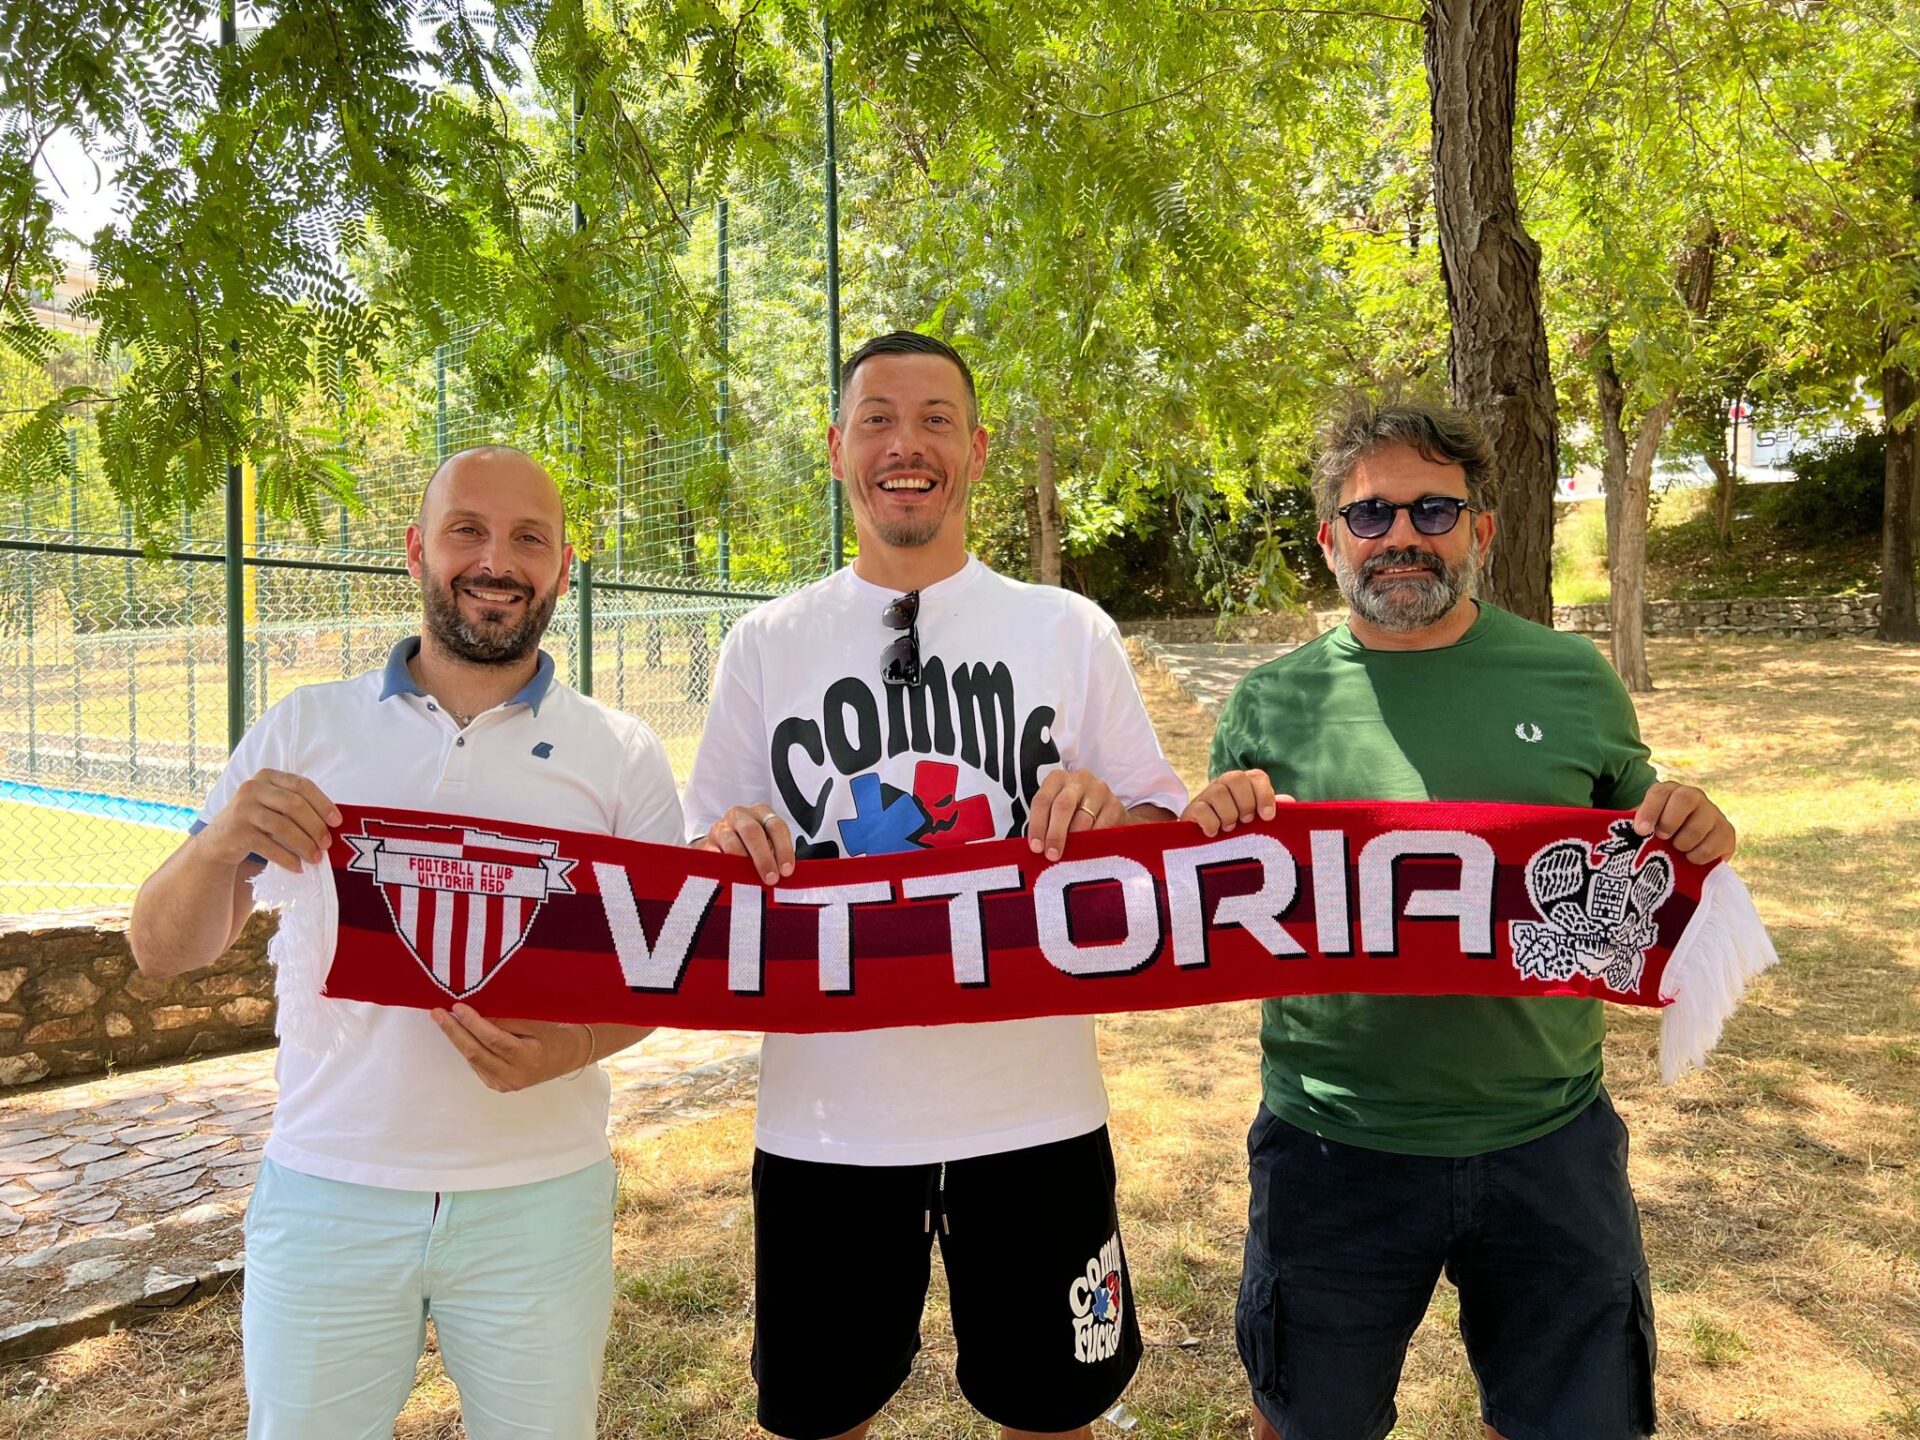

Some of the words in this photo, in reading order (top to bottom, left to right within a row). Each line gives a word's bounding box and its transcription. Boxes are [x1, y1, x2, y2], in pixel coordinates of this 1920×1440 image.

[409, 857, 474, 876] FOOTBALL
[481, 864, 514, 880] CLUB
[417, 872, 474, 891] VITTORIA
[480, 878, 505, 893] ASD
[592, 829, 1497, 996] VITTORIA
